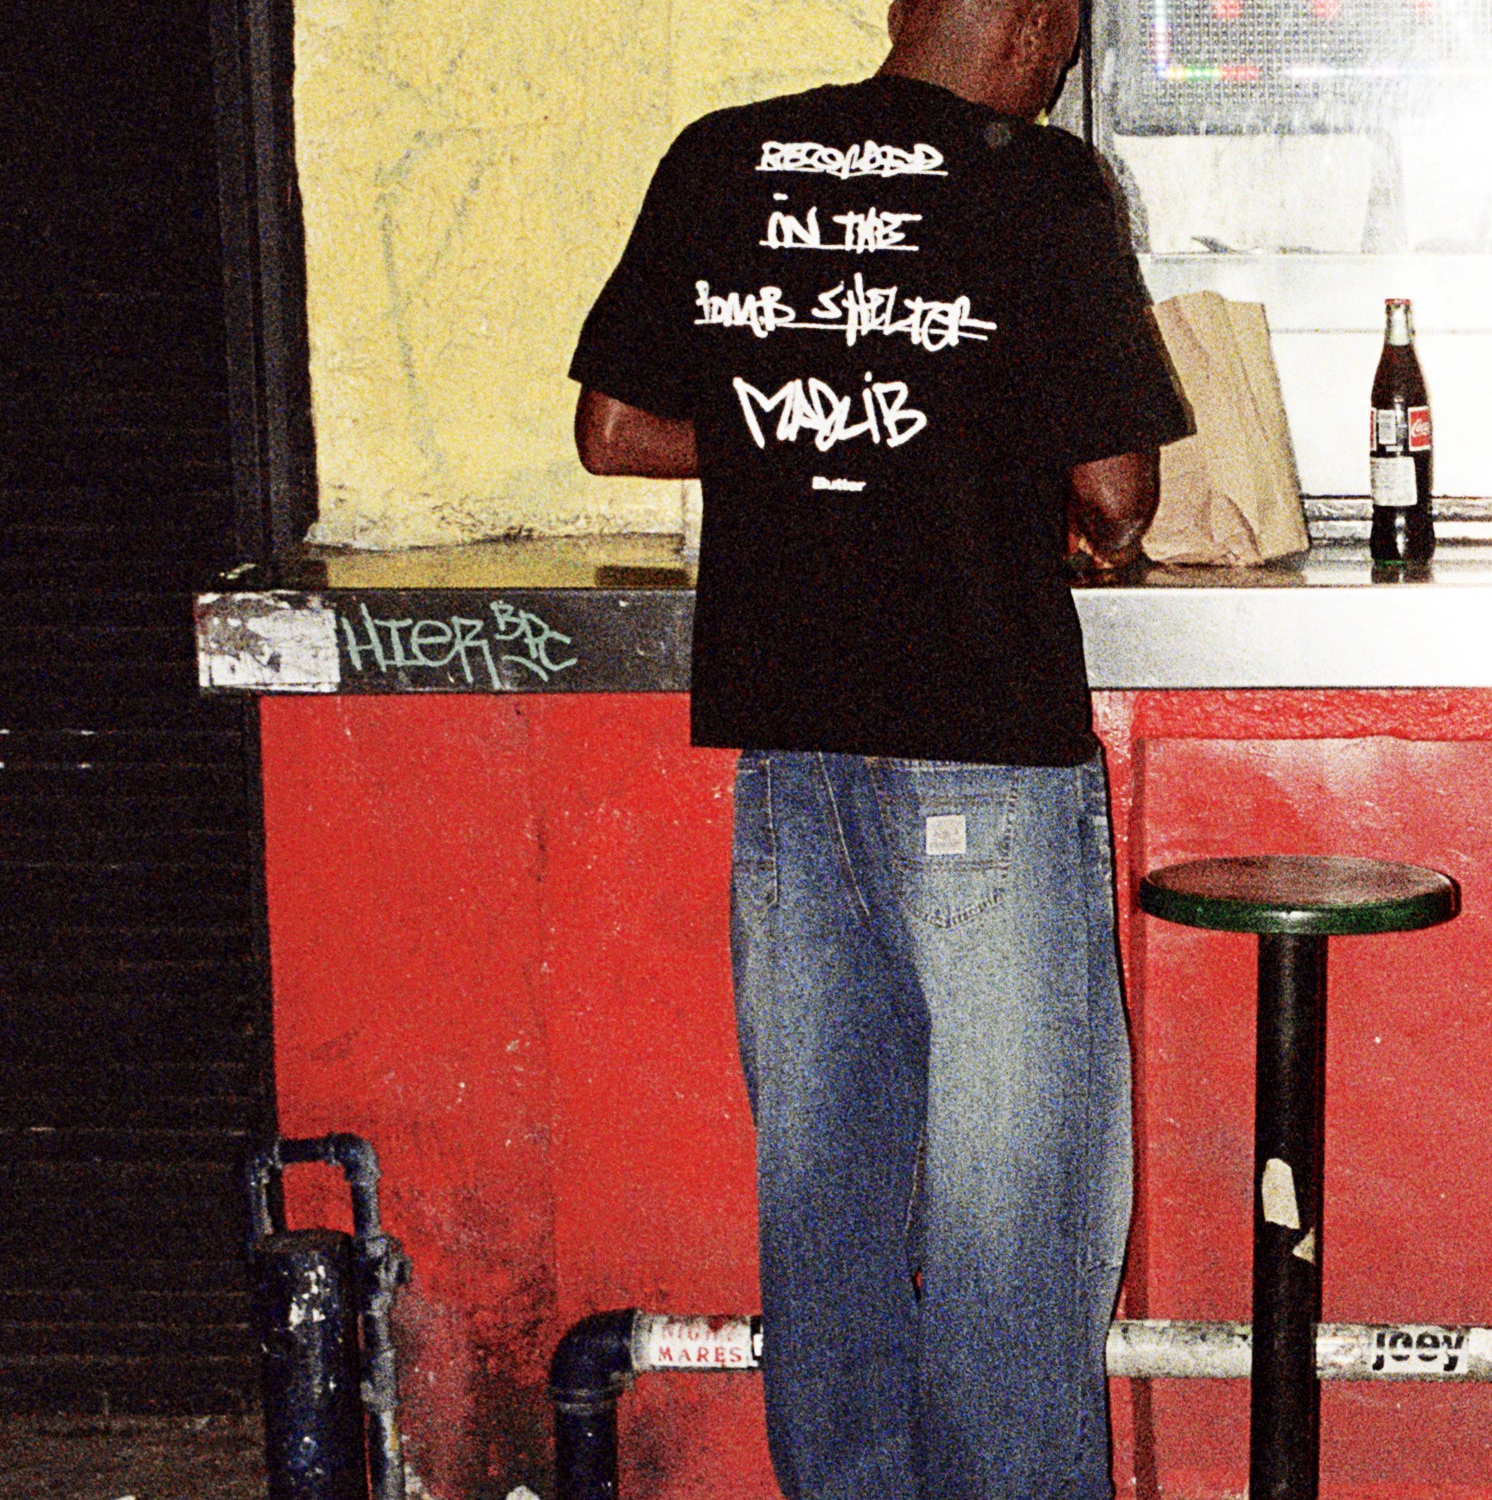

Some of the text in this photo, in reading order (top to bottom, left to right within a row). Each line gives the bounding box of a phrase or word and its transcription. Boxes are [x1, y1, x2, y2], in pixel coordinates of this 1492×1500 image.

[832, 206, 923, 254] THE
[811, 272, 997, 352] SHELTER
[658, 1345, 743, 1365] MARES
[1372, 1331, 1465, 1372] joey
